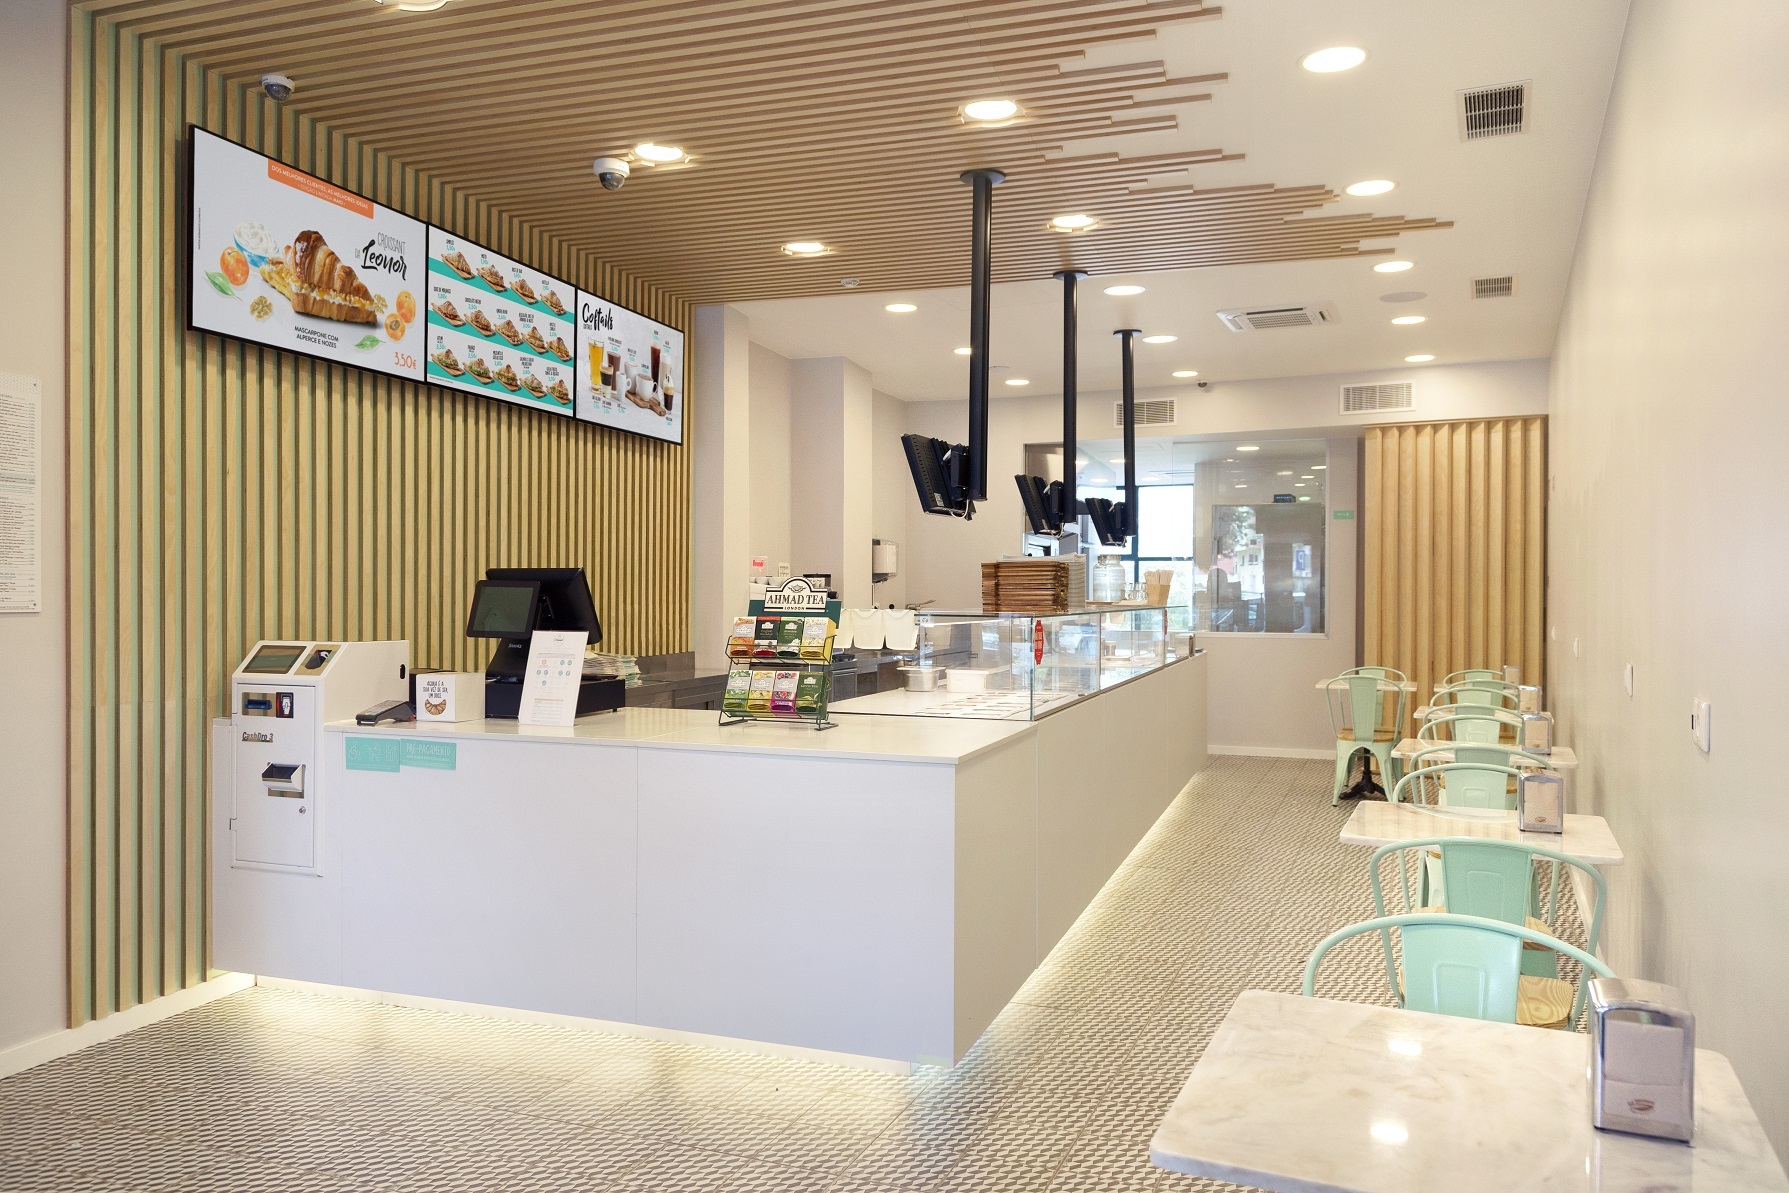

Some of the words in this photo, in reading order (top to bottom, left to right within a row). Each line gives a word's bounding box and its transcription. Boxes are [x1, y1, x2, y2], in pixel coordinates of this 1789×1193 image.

[271, 165, 282, 174] DOS
[282, 169, 307, 184] MELHORES
[334, 190, 355, 204] MELHORES
[355, 200, 369, 209] IDEIAS
[361, 239, 407, 281] Leonor
[294, 326, 327, 340] MASCARPONE
[327, 334, 339, 342] COM
[296, 333, 317, 344] ALPERCE
[321, 340, 337, 348] NOZES
[394, 351, 417, 369] 3,50€
[766, 594, 805, 605] AHMAD
[805, 594, 825, 605] TEA
